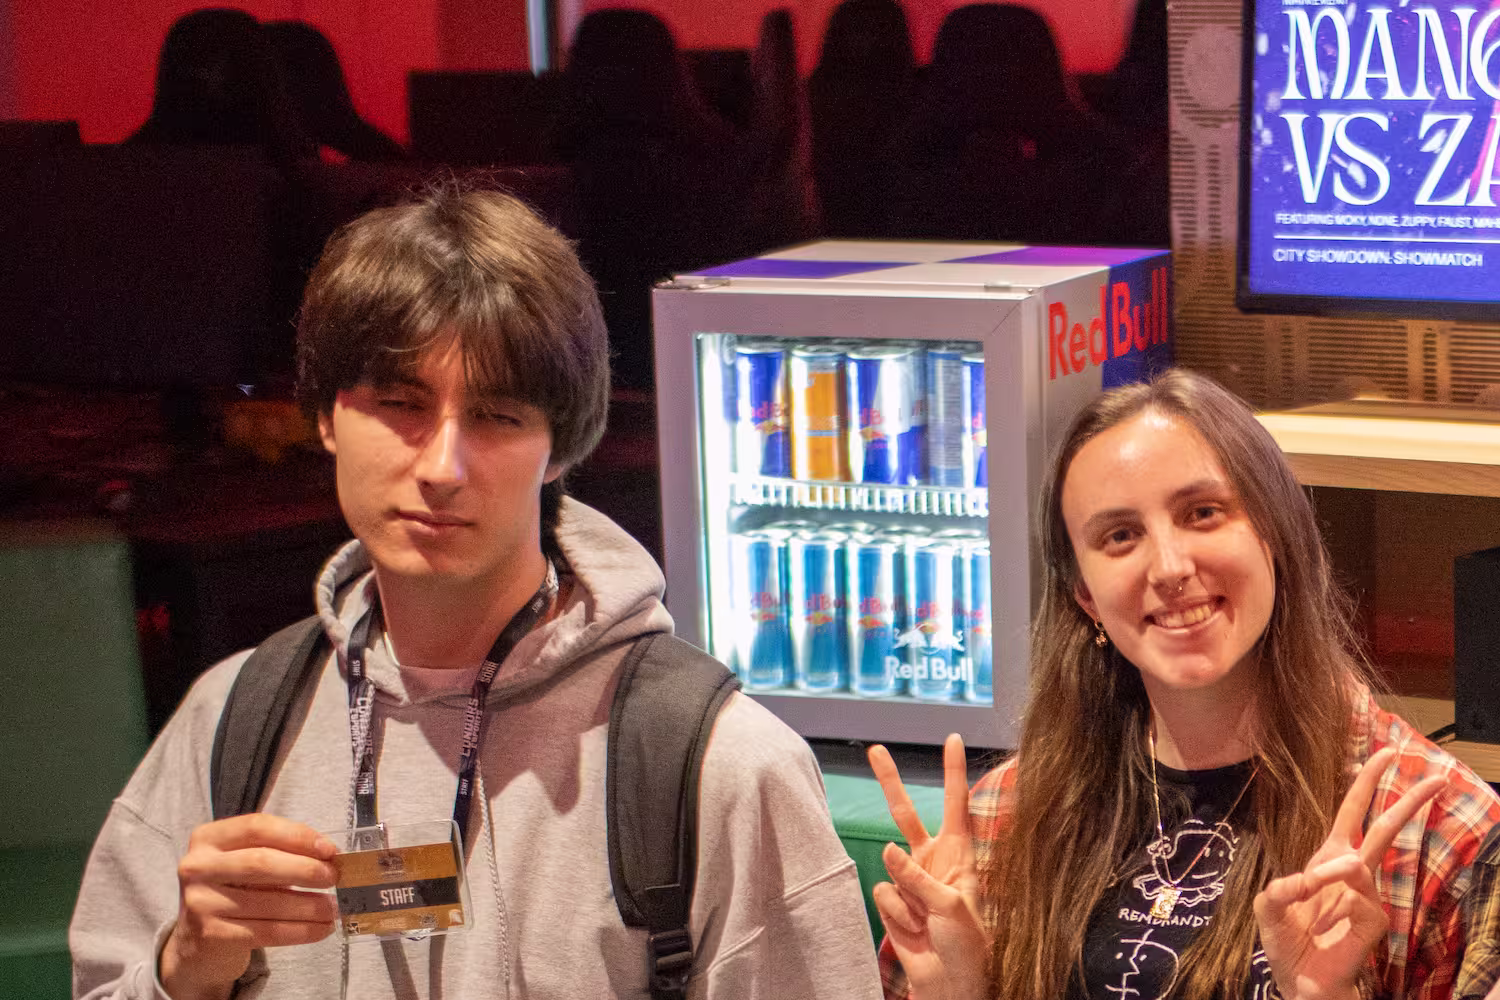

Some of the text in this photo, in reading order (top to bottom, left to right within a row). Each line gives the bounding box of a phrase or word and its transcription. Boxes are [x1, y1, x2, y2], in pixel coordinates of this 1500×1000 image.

[1279, 112, 1390, 206] VS
[1273, 249, 1306, 262] CITY
[1393, 251, 1483, 267] SHOWMATCH
[1048, 267, 1167, 380] Red Bull
[884, 656, 974, 682] Red Bull
[380, 886, 415, 907] STAFF
